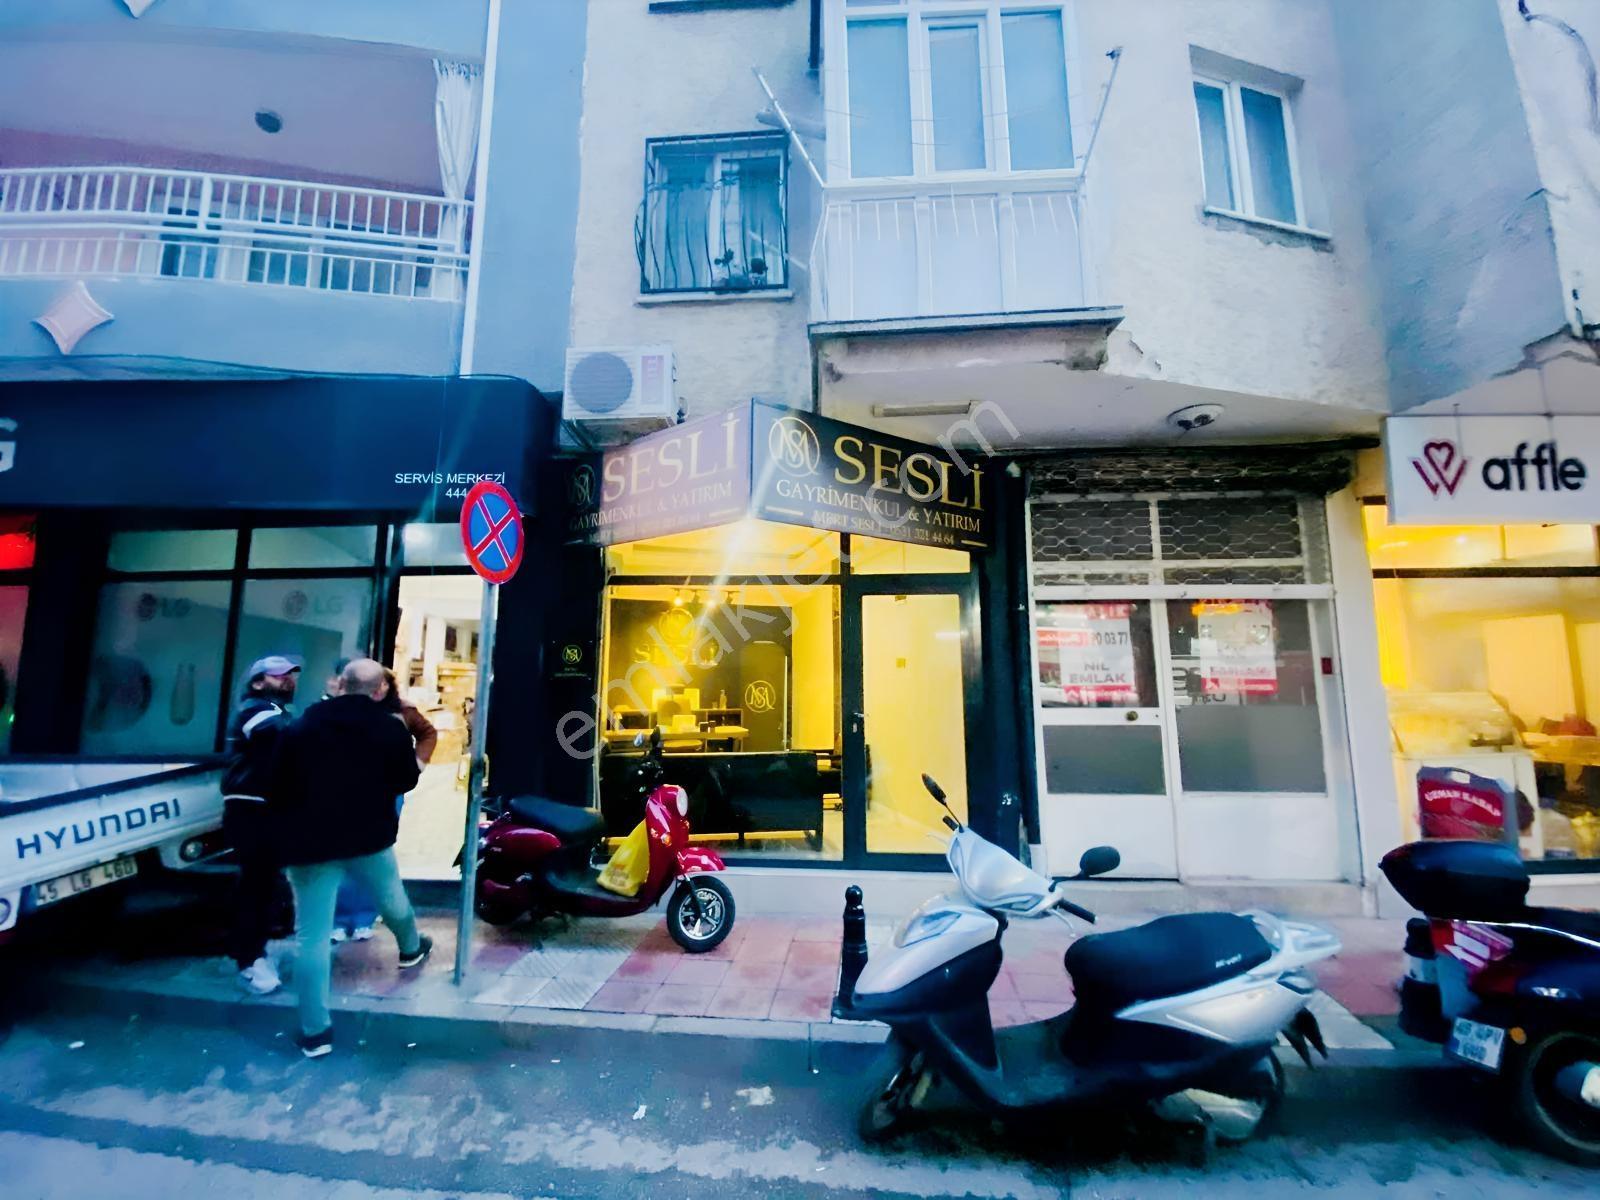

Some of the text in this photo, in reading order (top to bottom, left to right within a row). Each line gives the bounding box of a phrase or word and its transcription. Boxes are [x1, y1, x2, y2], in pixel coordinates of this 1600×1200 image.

[395, 471, 443, 484] SERVİS
[603, 412, 741, 503] SESLİ
[834, 435, 985, 511] SESLİ
[776, 479, 905, 519] GAYRİMENKUL
[923, 507, 981, 533] YATIRIM
[1069, 673, 1126, 684] EMLAK
[17, 798, 181, 860] HYUNDAI
